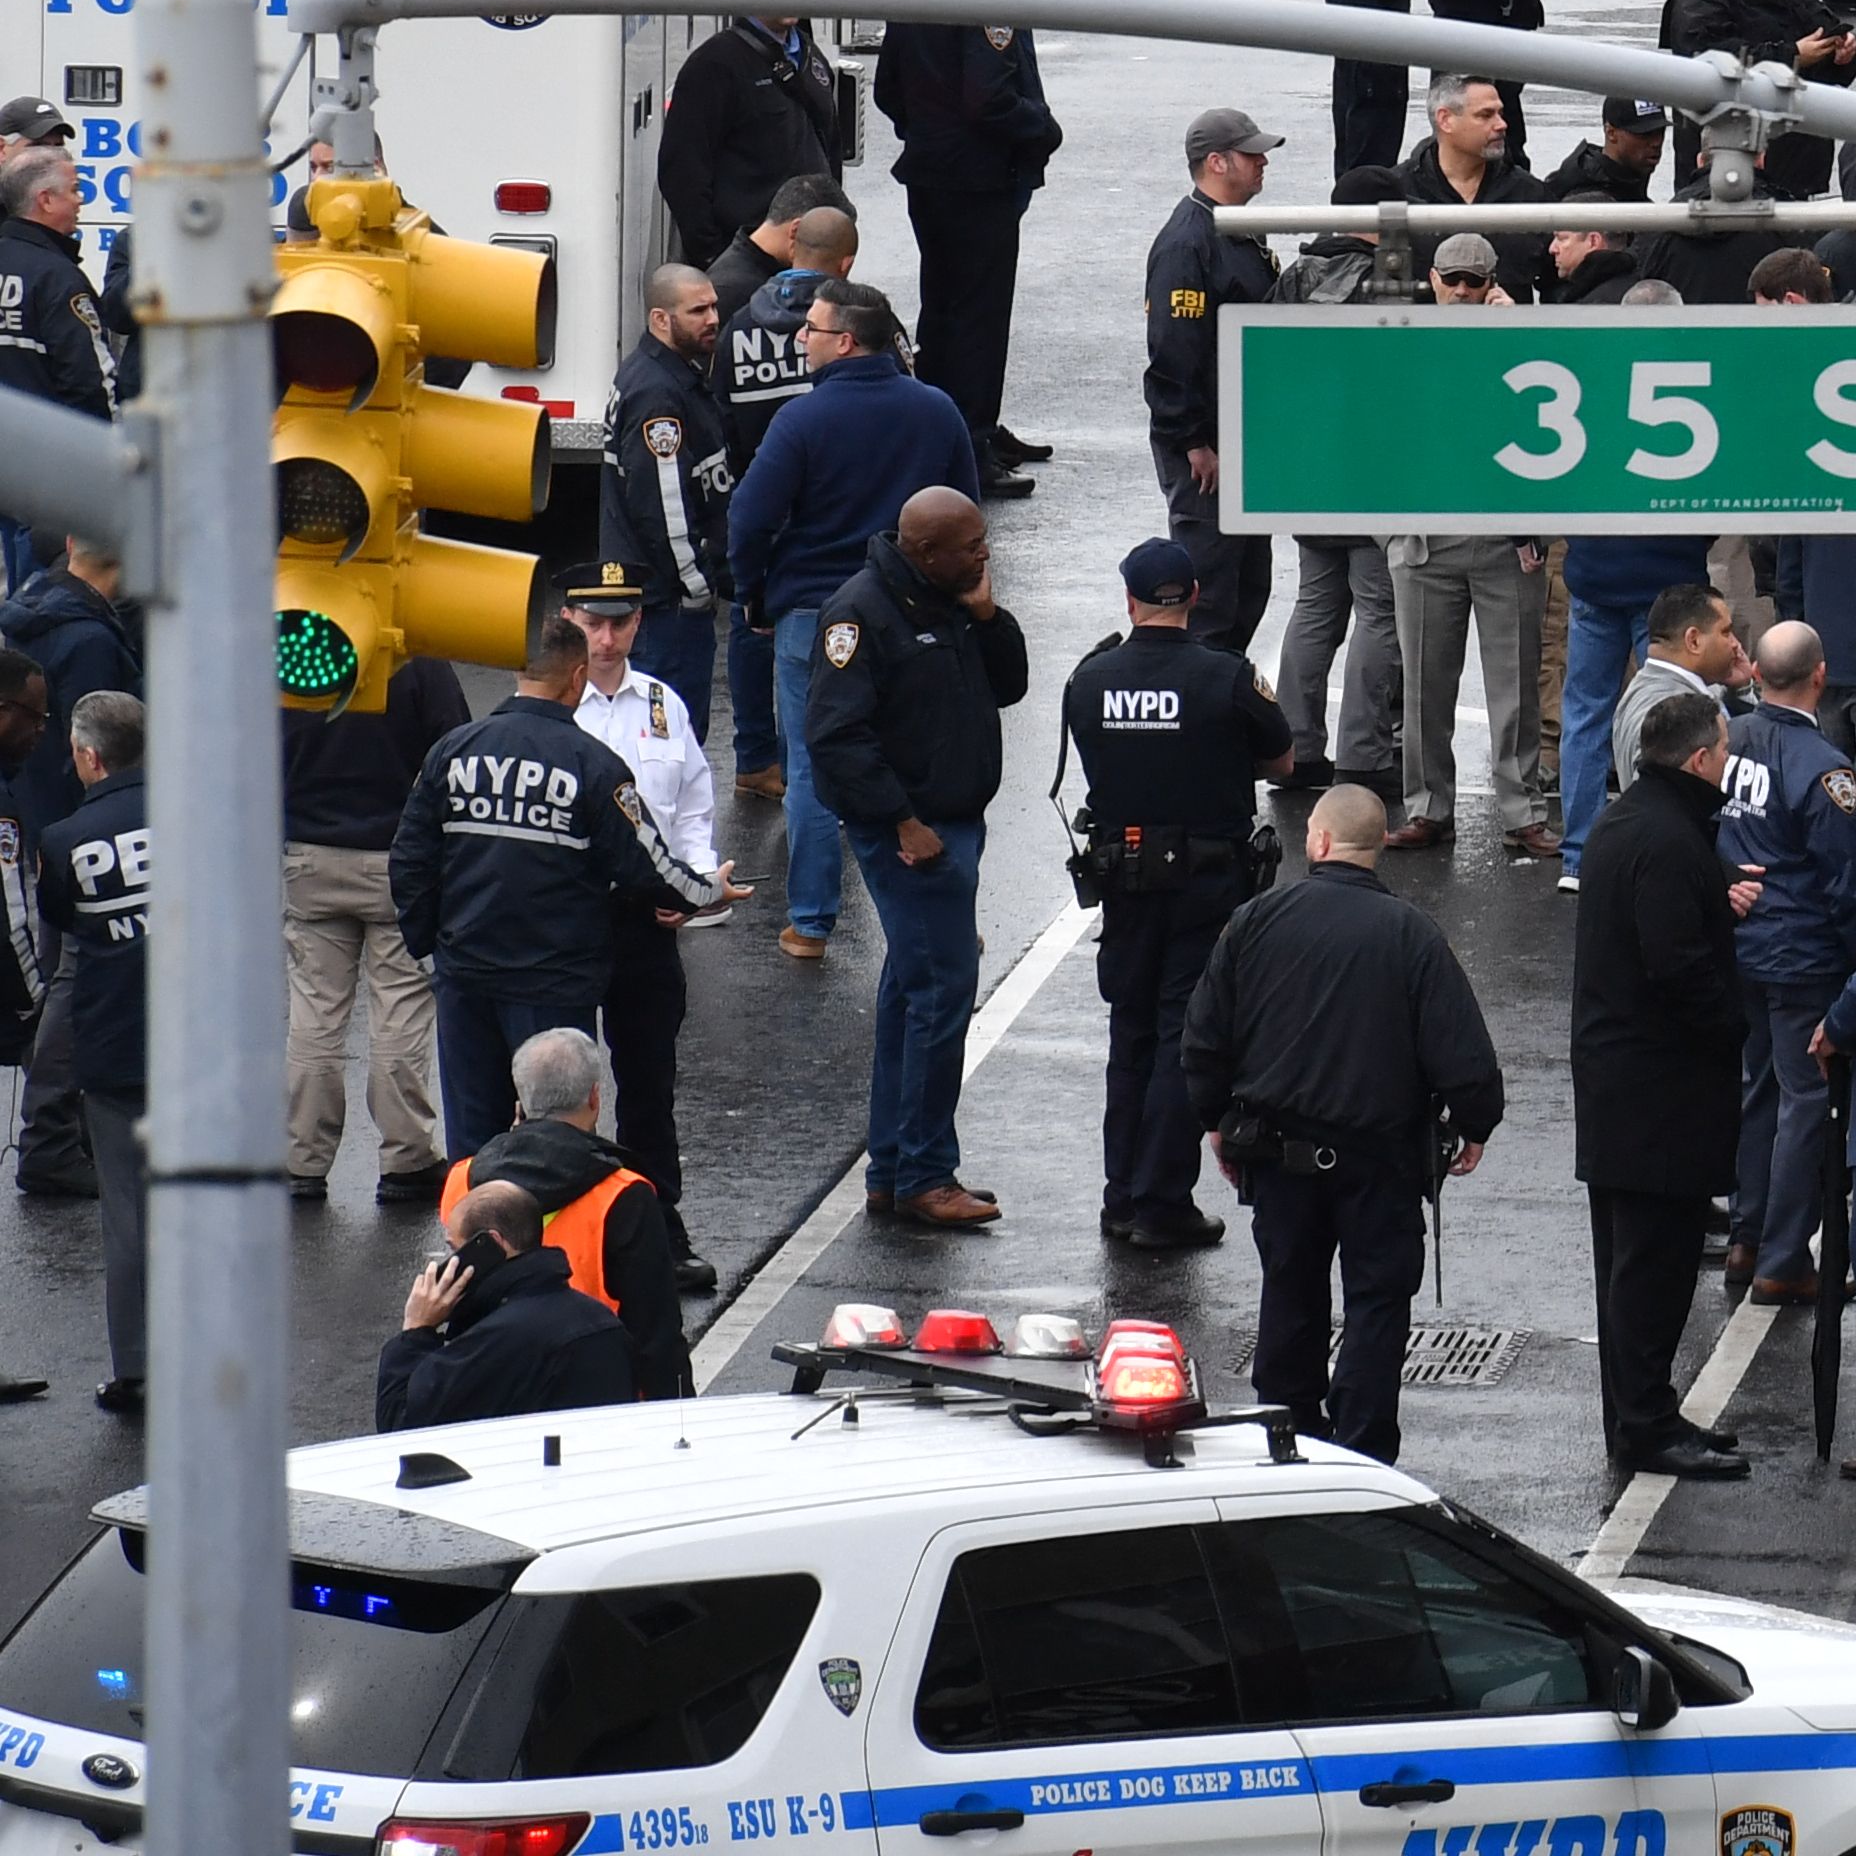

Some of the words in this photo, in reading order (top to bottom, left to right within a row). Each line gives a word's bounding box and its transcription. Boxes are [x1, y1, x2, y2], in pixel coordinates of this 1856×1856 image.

[1170, 289, 1206, 308] FBI
[1493, 359, 1720, 479] 35
[1650, 499, 1686, 509] DEPT
[1690, 499, 1710, 509] OF
[1714, 499, 1844, 509] TRANSPORTATION
[1103, 689, 1180, 721] NYPD
[447, 755, 579, 808] NYPD
[451, 795, 574, 832] POLICE
[90, 1755, 131, 1782] Ford
[1030, 1781, 1108, 1806] POLICE
[1118, 1775, 1165, 1800] DOG
[1174, 1770, 1231, 1796] KEEP
[1240, 1764, 1301, 1790] BACK
[629, 1807, 693, 1850] 4395
[694, 1826, 710, 1845] 18
[730, 1797, 777, 1842] ESU
[785, 1790, 836, 1838] K-9
[1737, 1810, 1786, 1825] POLICE
[1723, 1823, 1791, 1847] DEPARTMENT
